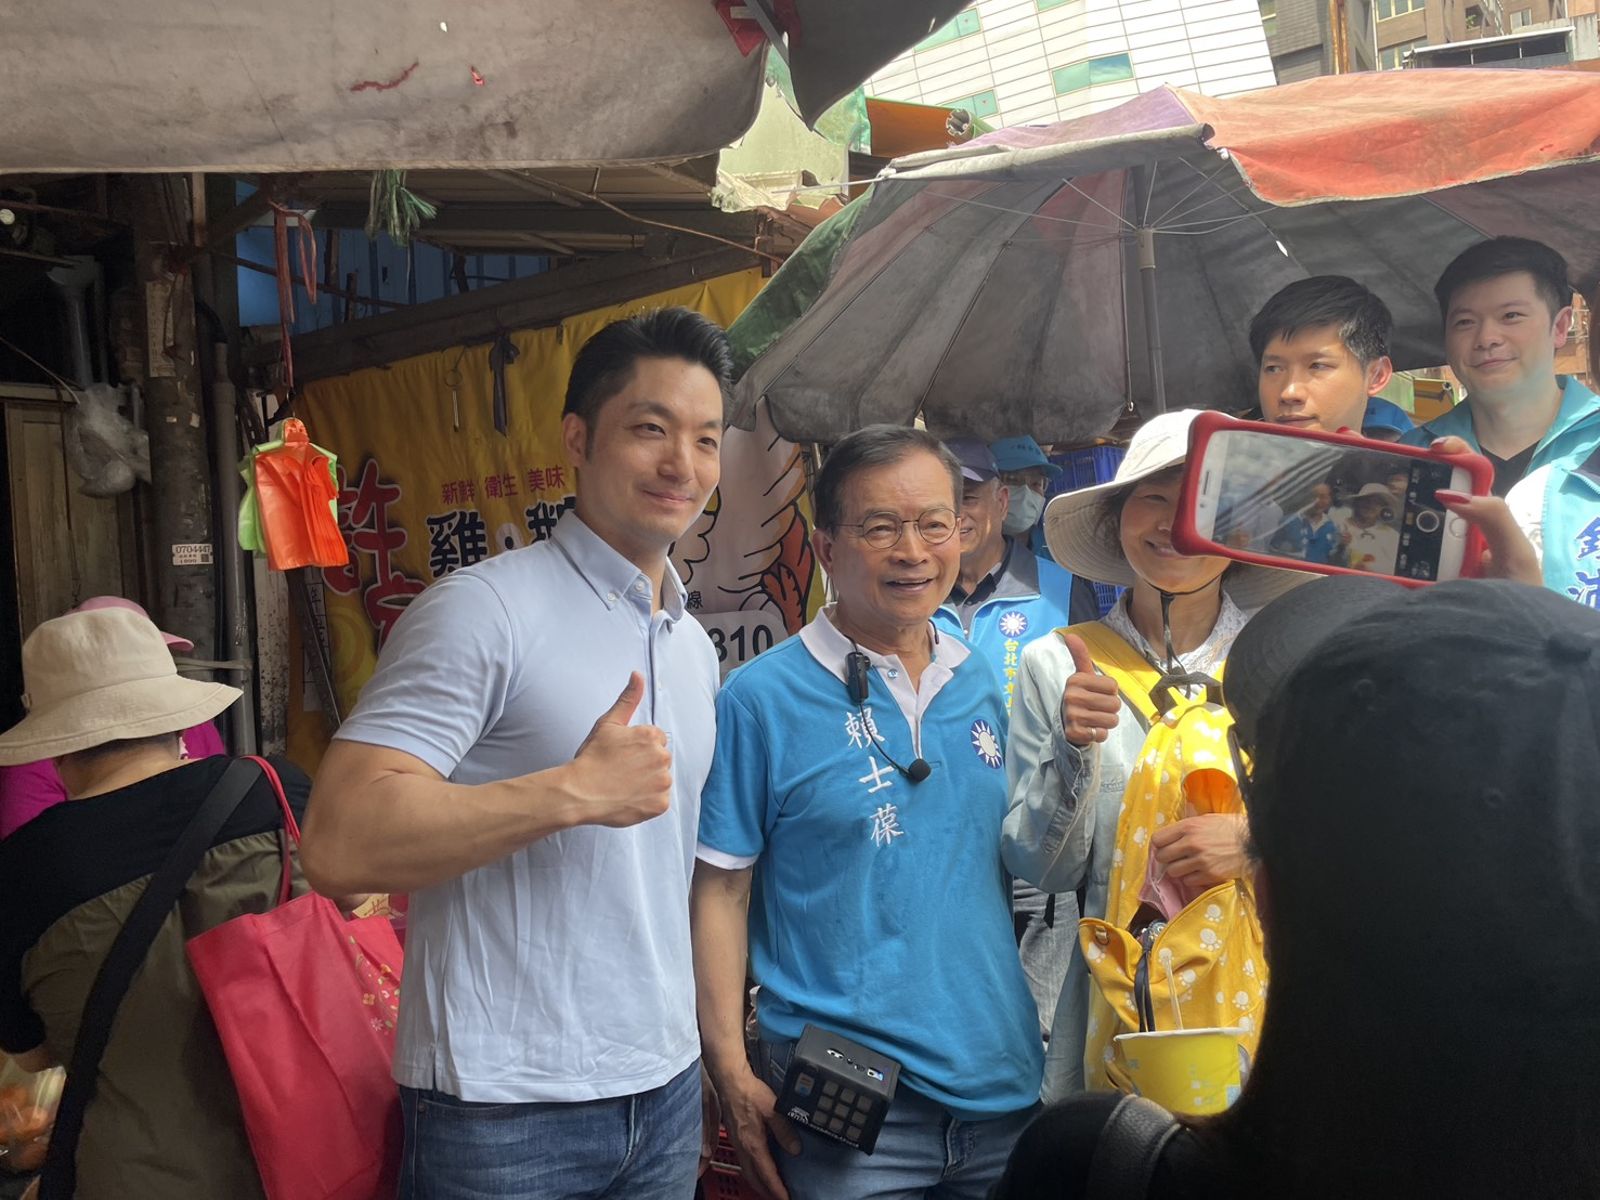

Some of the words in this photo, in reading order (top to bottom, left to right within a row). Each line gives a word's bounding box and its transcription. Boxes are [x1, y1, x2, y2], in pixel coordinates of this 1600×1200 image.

[442, 480, 475, 505] 新鮮
[485, 474, 518, 499] 衛生
[528, 465, 566, 493] 美味
[844, 706, 904, 848] 賴士葆
